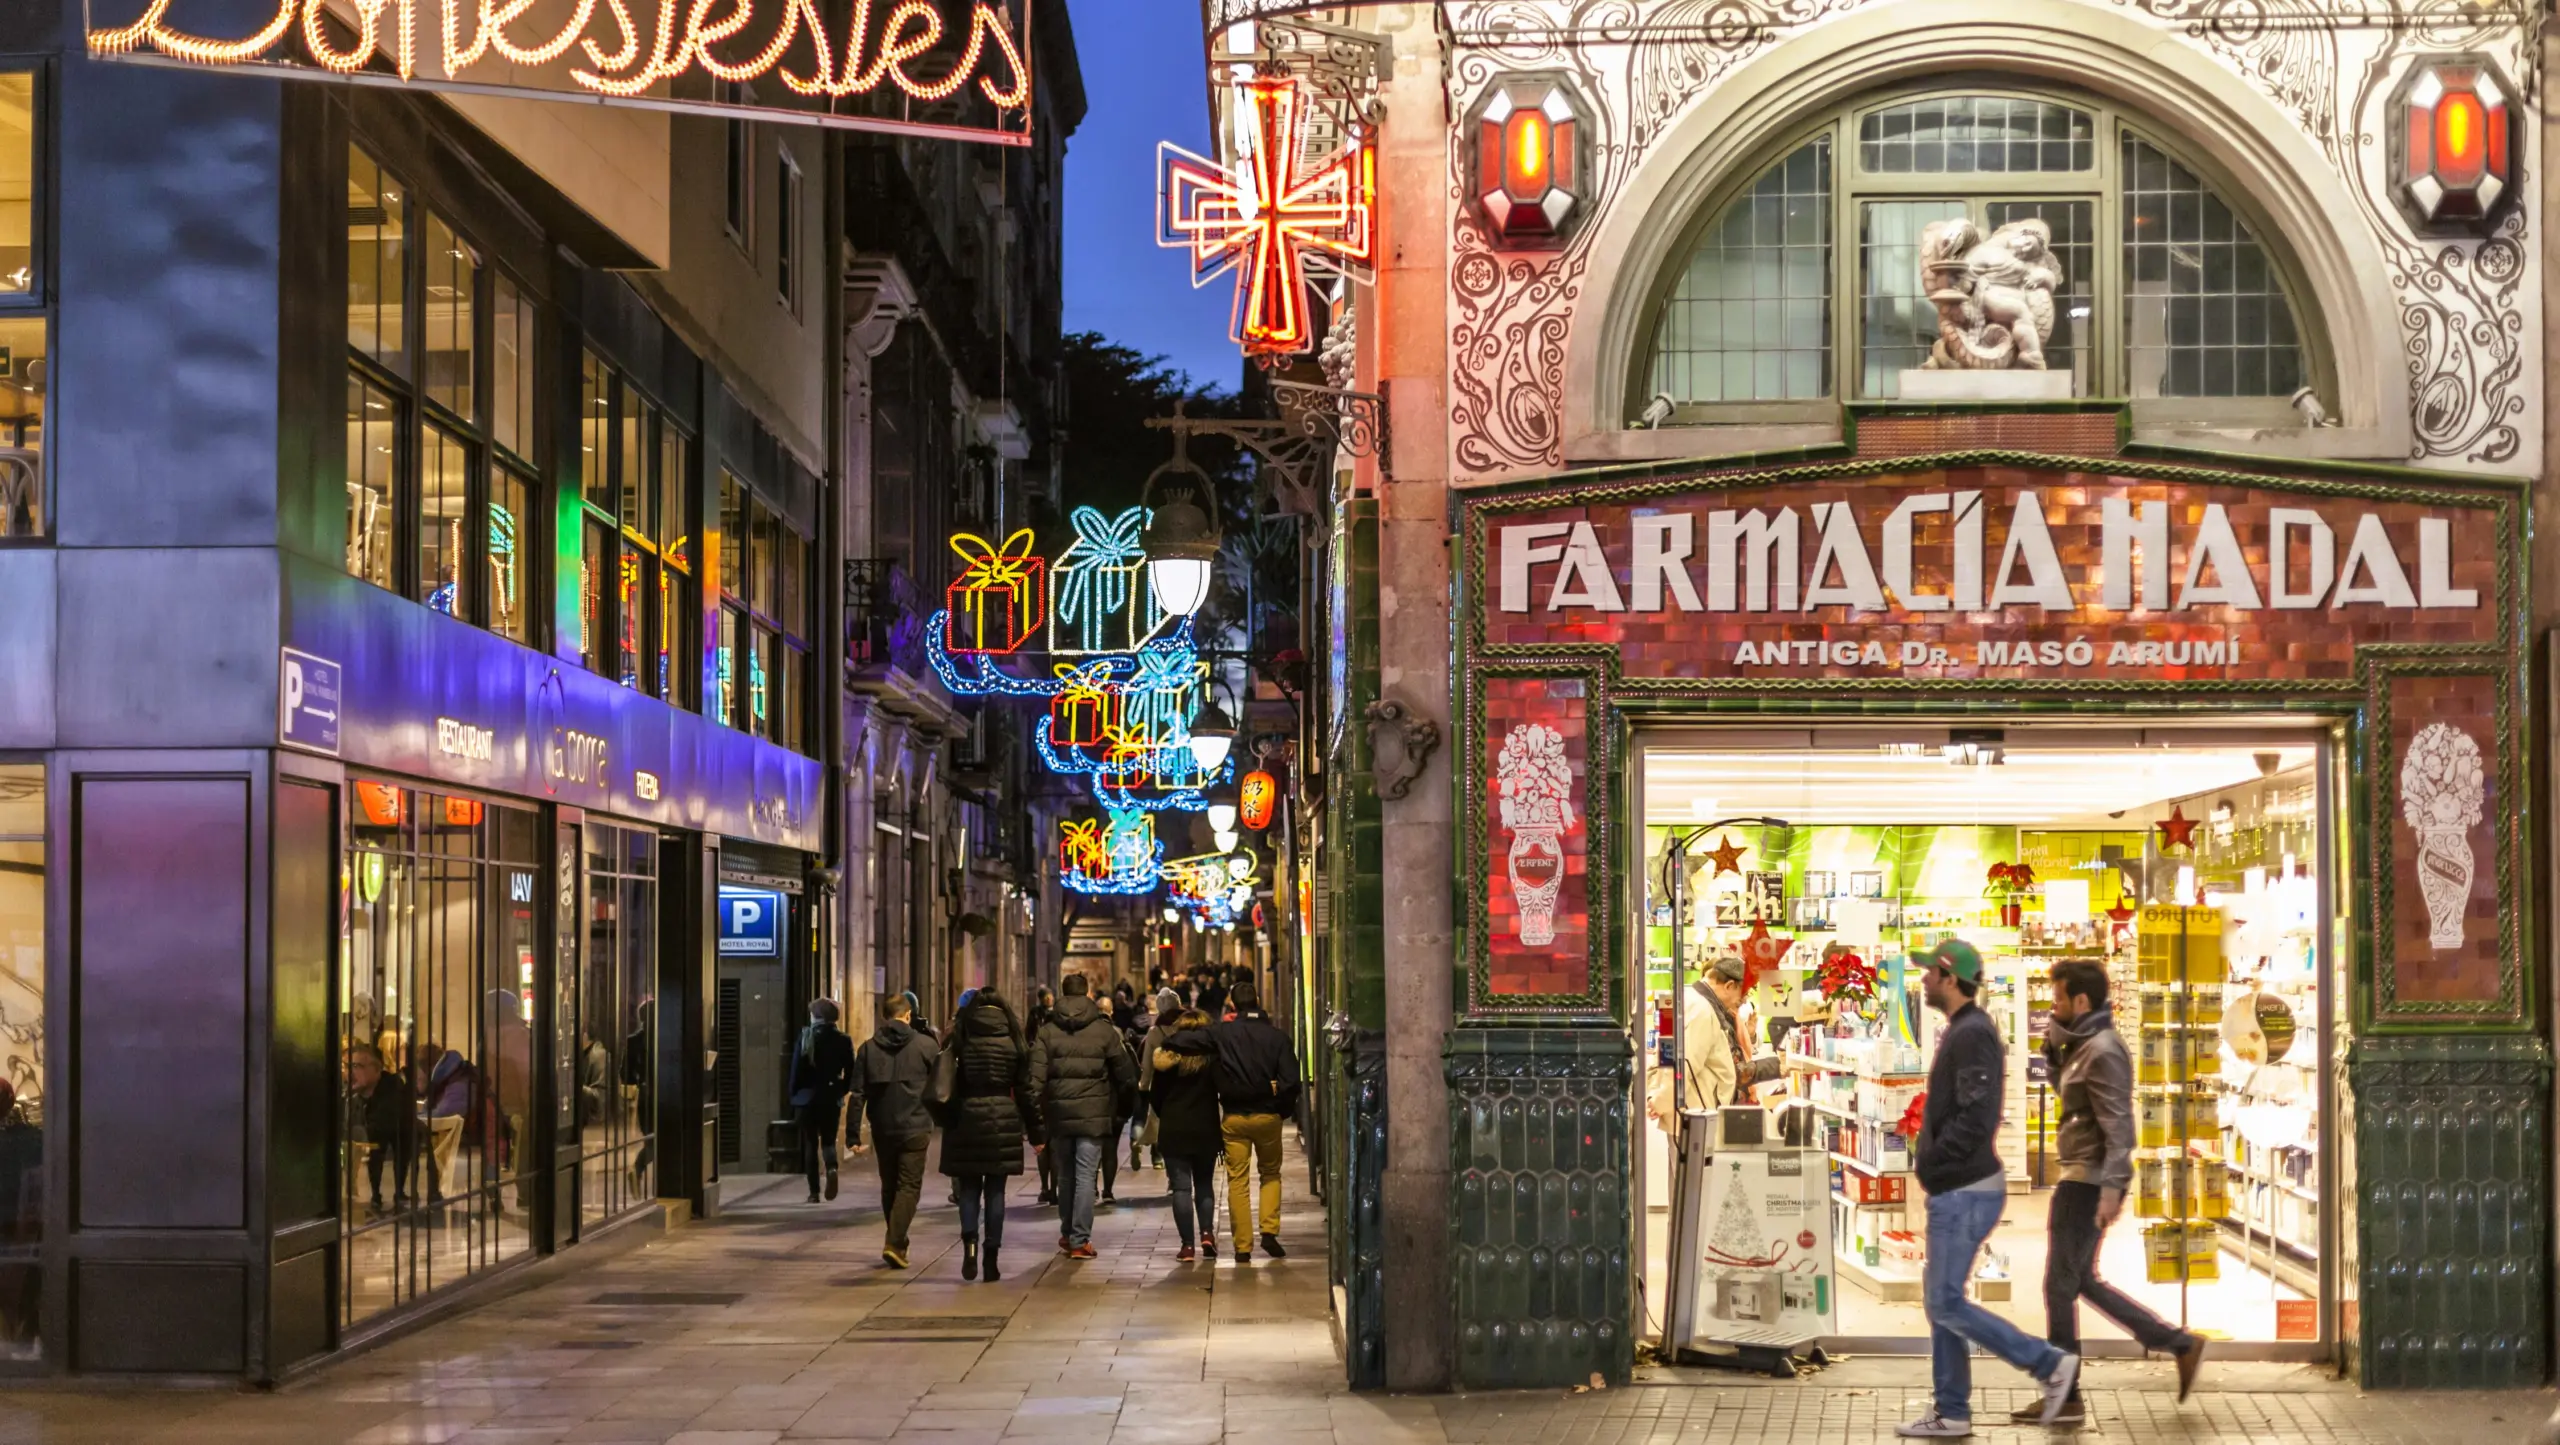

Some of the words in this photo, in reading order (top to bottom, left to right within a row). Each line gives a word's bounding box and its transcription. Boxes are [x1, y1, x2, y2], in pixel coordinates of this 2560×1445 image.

[2102, 498, 2479, 610] NADAL
[1733, 641, 1888, 666] ANTIGA
[1978, 635, 2093, 666] MASÓ
[2107, 634, 2239, 666] ARUMÍ
[285, 660, 303, 734] P
[438, 717, 494, 762] RESTAURANT
[733, 900, 761, 934] P
[721, 940, 744, 948] HOTEL
[746, 940, 770, 948] ROYAL
